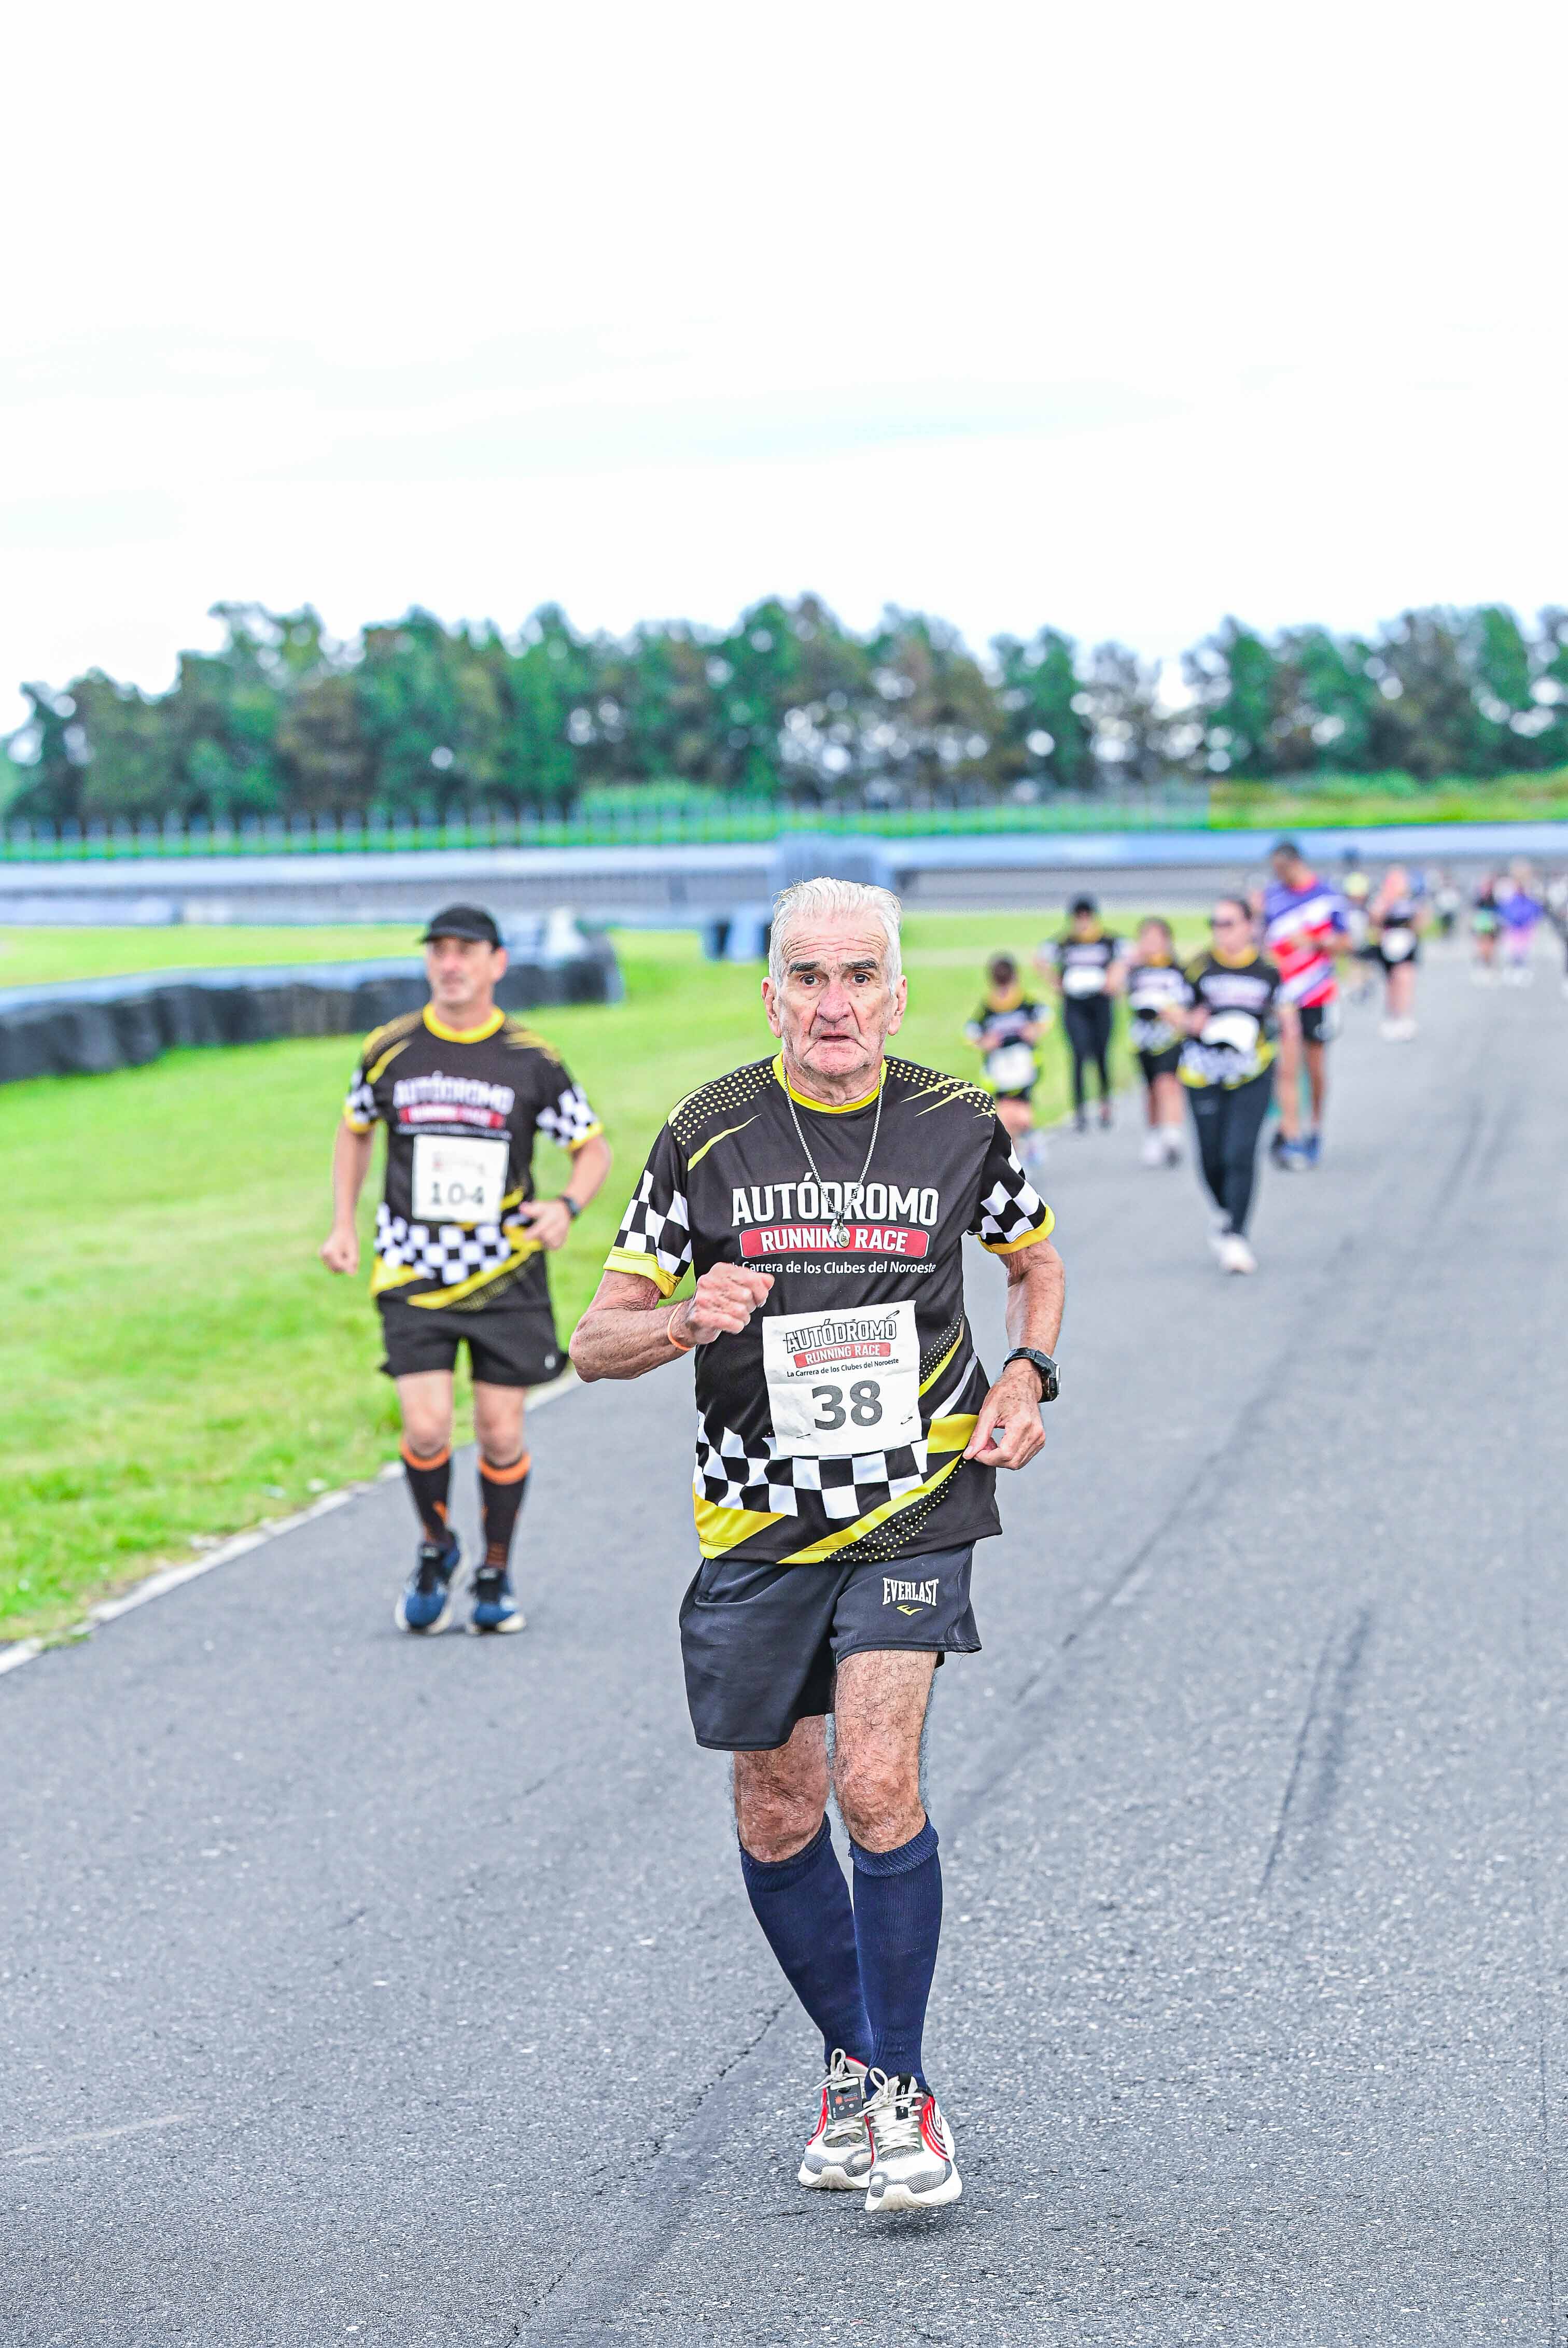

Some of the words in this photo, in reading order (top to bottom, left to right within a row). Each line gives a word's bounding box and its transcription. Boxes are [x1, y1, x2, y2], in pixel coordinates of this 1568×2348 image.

[431, 1182, 484, 1207] 104
[731, 1172, 939, 1227] AUTÓDROMO
[854, 1227, 909, 1253] RACE
[786, 1261, 801, 1273] de
[804, 1261, 821, 1274] los
[823, 1262, 865, 1274] Clubes
[868, 1261, 887, 1273] del
[890, 1261, 936, 1274] Noroeste
[786, 1319, 897, 1353] AUTÓDROMO
[805, 1346, 851, 1365] RUNNING
[854, 1344, 880, 1357] RACE
[841, 1363, 862, 1372] Clubes
[874, 1358, 899, 1366] Noroeste
[811, 1380, 883, 1430] 38
[883, 1577, 939, 1606] EVERLAST
